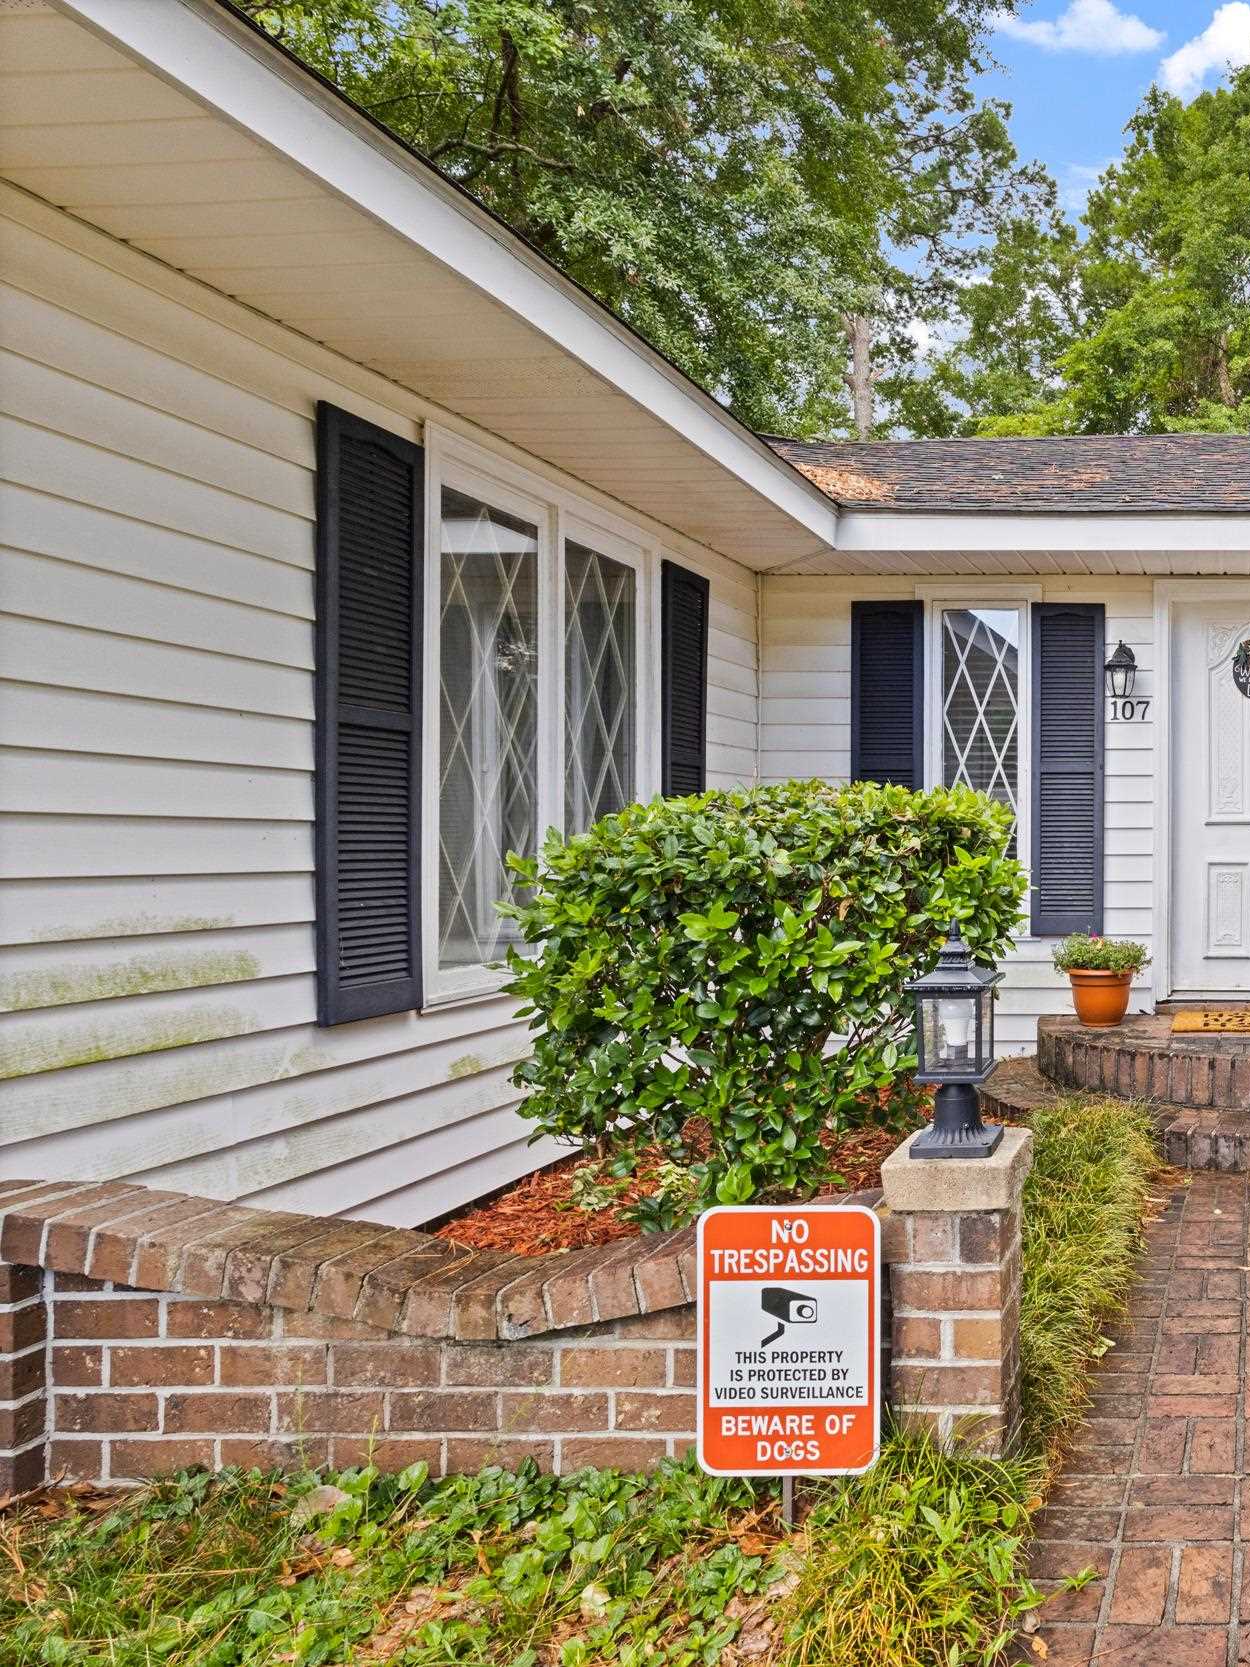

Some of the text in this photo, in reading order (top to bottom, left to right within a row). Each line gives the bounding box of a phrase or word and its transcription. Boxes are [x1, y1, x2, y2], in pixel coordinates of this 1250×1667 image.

[1110, 700, 1150, 721] 107
[770, 1219, 810, 1244] NO
[710, 1248, 869, 1274] TRESPASSING
[735, 1351, 843, 1364] THIS PROPERTY
[730, 1368, 849, 1382] IS PROTECTED BY
[715, 1386, 864, 1400] VIDEO SURVEILLANCE
[721, 1414, 856, 1437] BEWARE OF
[756, 1440, 821, 1462] DOGS
